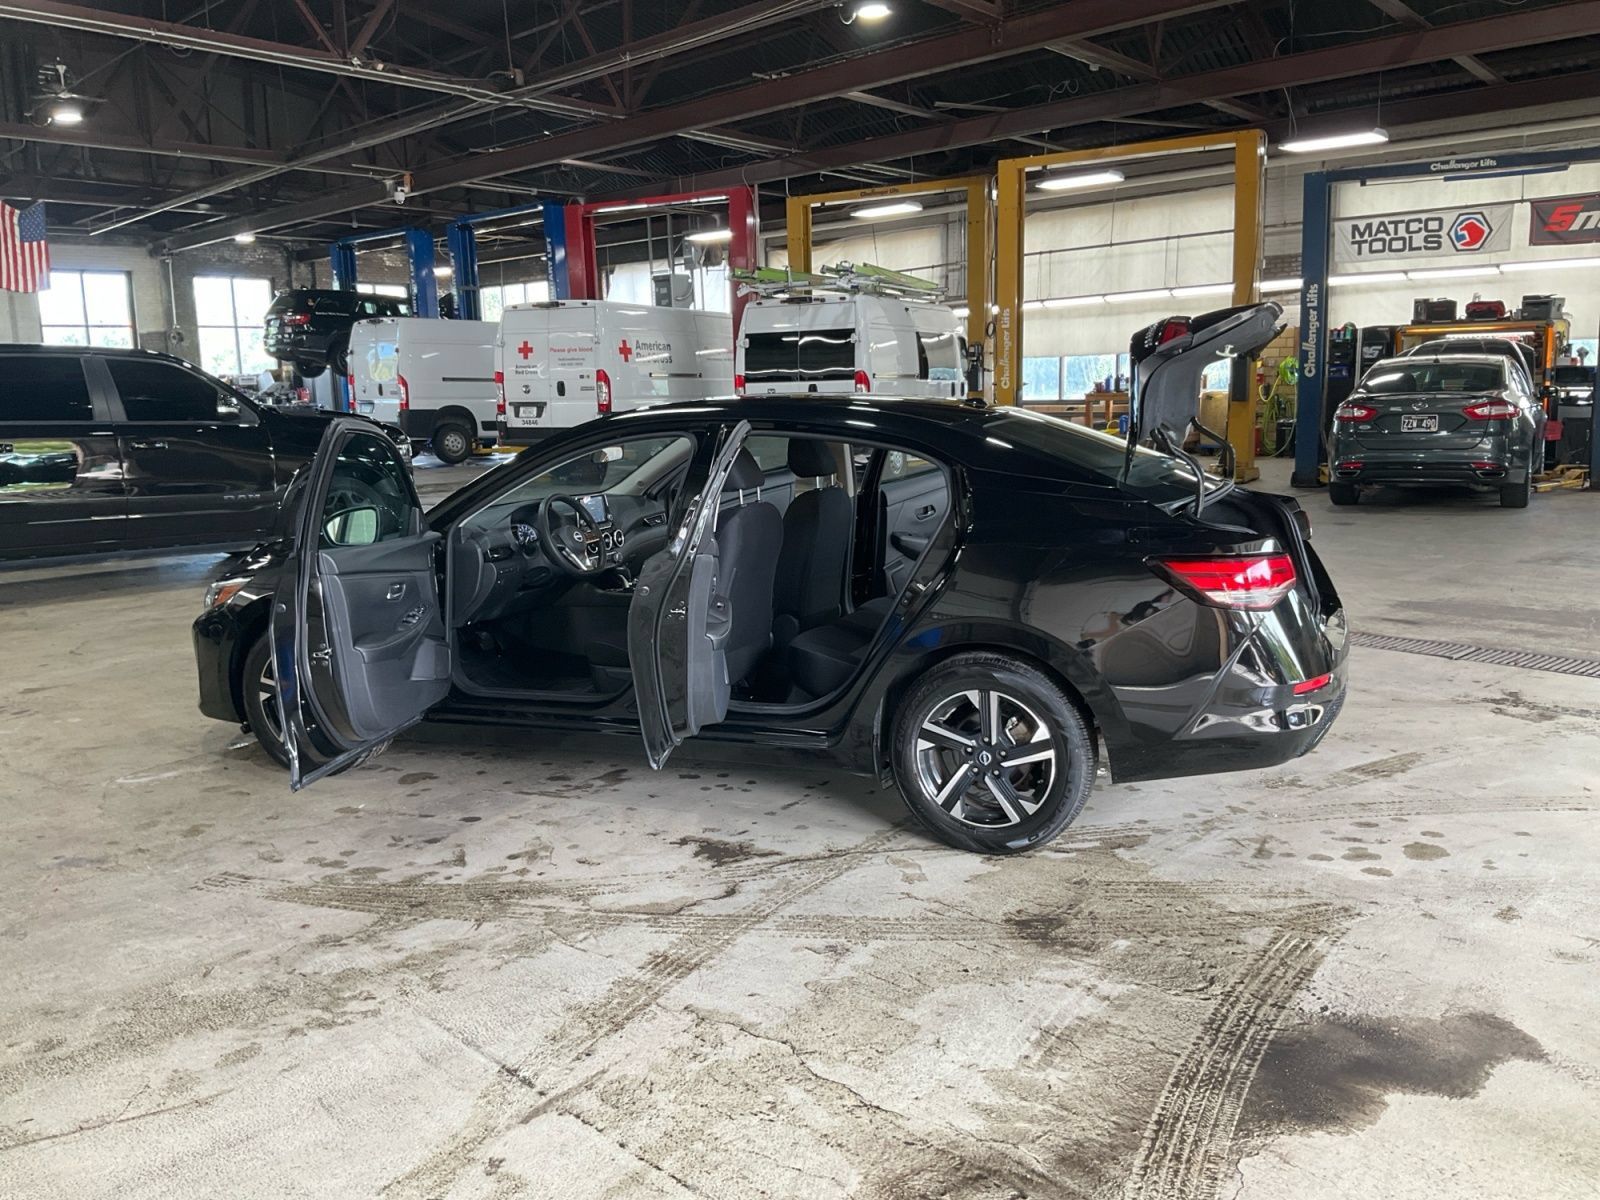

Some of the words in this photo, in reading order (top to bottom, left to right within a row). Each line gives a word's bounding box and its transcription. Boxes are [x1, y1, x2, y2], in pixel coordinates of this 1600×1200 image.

[1430, 159, 1478, 171] Challenger
[1480, 158, 1497, 167] Lifts
[1351, 216, 1444, 240] MATCO
[1543, 204, 1600, 232] Sn
[1351, 233, 1443, 256] TOOLS
[1306, 283, 1319, 307] Lifts
[1001, 307, 1010, 329] Lifts
[635, 339, 671, 352] American
[1301, 309, 1319, 377] Challenger
[1000, 330, 1011, 390] Challenger
